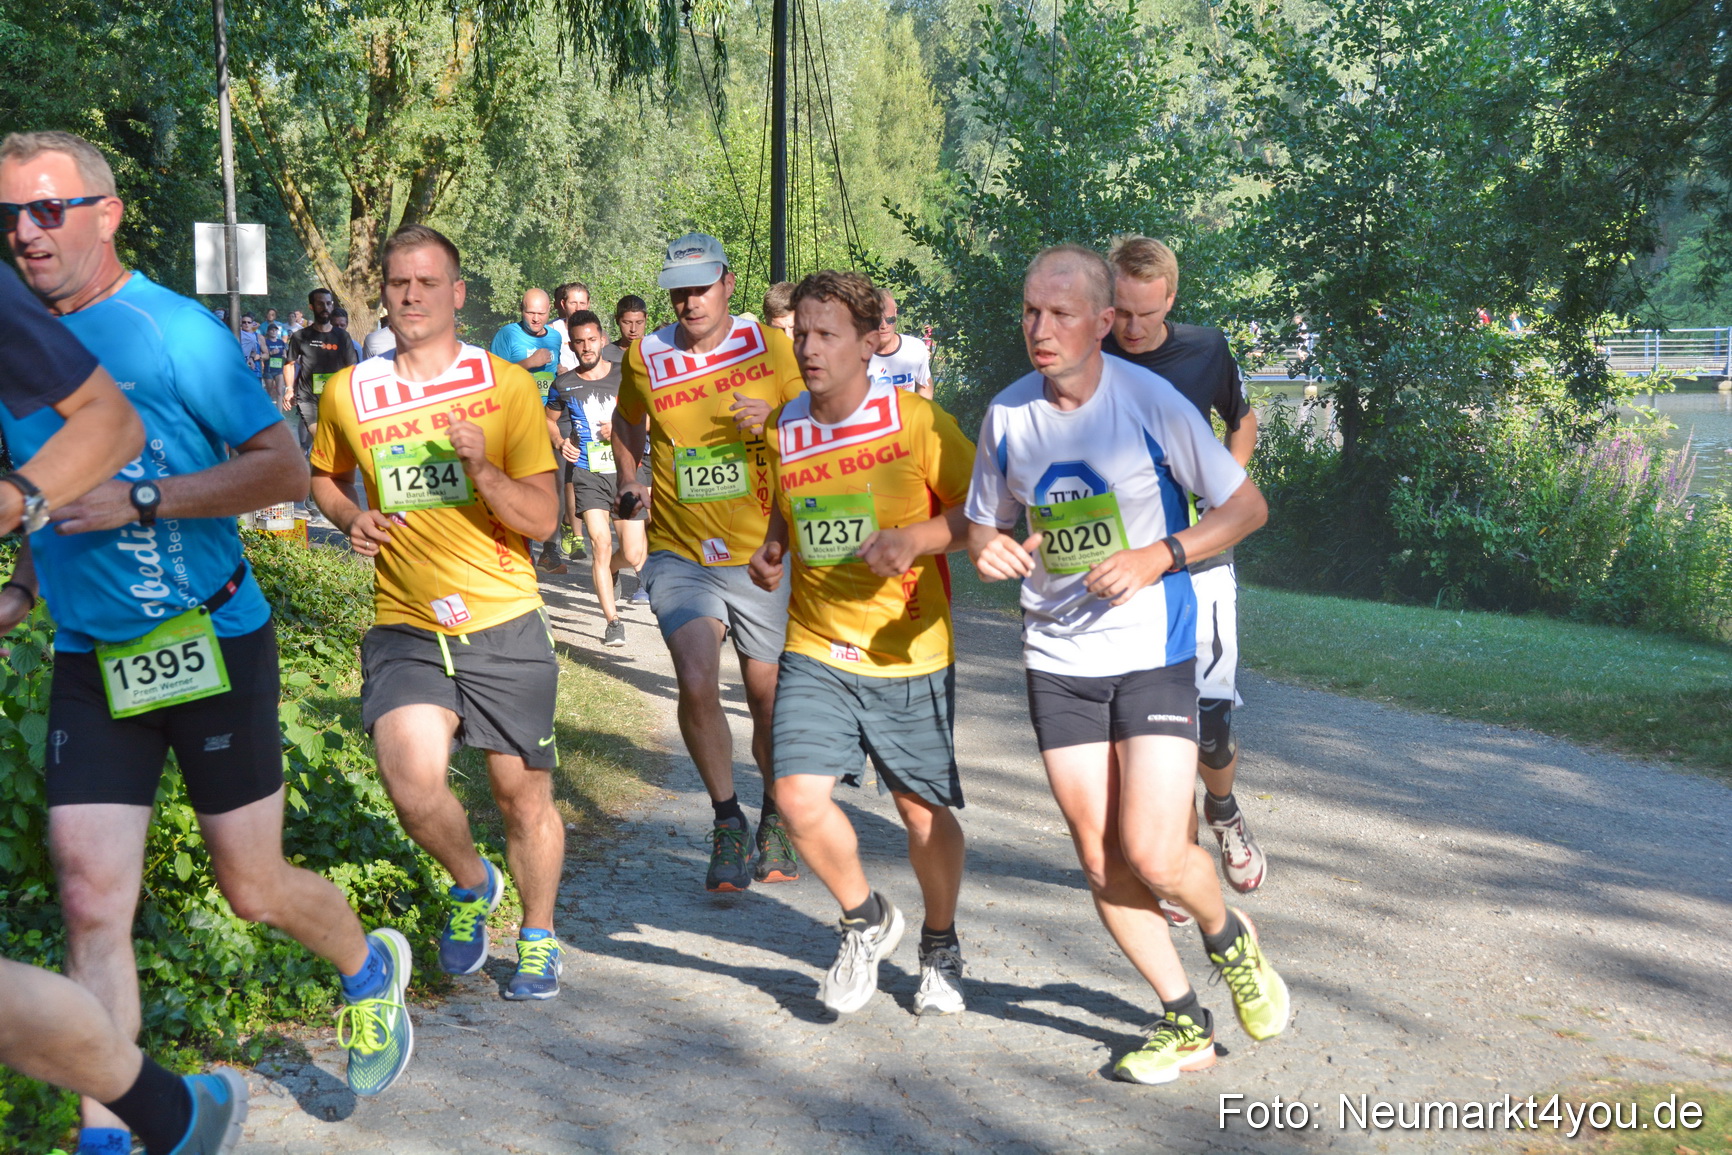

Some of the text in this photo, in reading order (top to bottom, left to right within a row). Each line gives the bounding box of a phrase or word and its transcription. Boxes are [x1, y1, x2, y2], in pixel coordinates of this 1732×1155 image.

[537, 380, 549, 390] 88
[654, 362, 775, 413] MAX BÖGL
[360, 398, 501, 449] MAX BÖGL
[389, 463, 459, 491] 1234
[684, 463, 739, 487] 1263
[780, 442, 910, 491] MAX BÖGL
[803, 519, 864, 545] 1237
[1042, 522, 1111, 554] 2020
[1078, 550, 1104, 560] Jochen
[113, 641, 205, 690] 1395
[133, 677, 193, 697] Prem Werner
